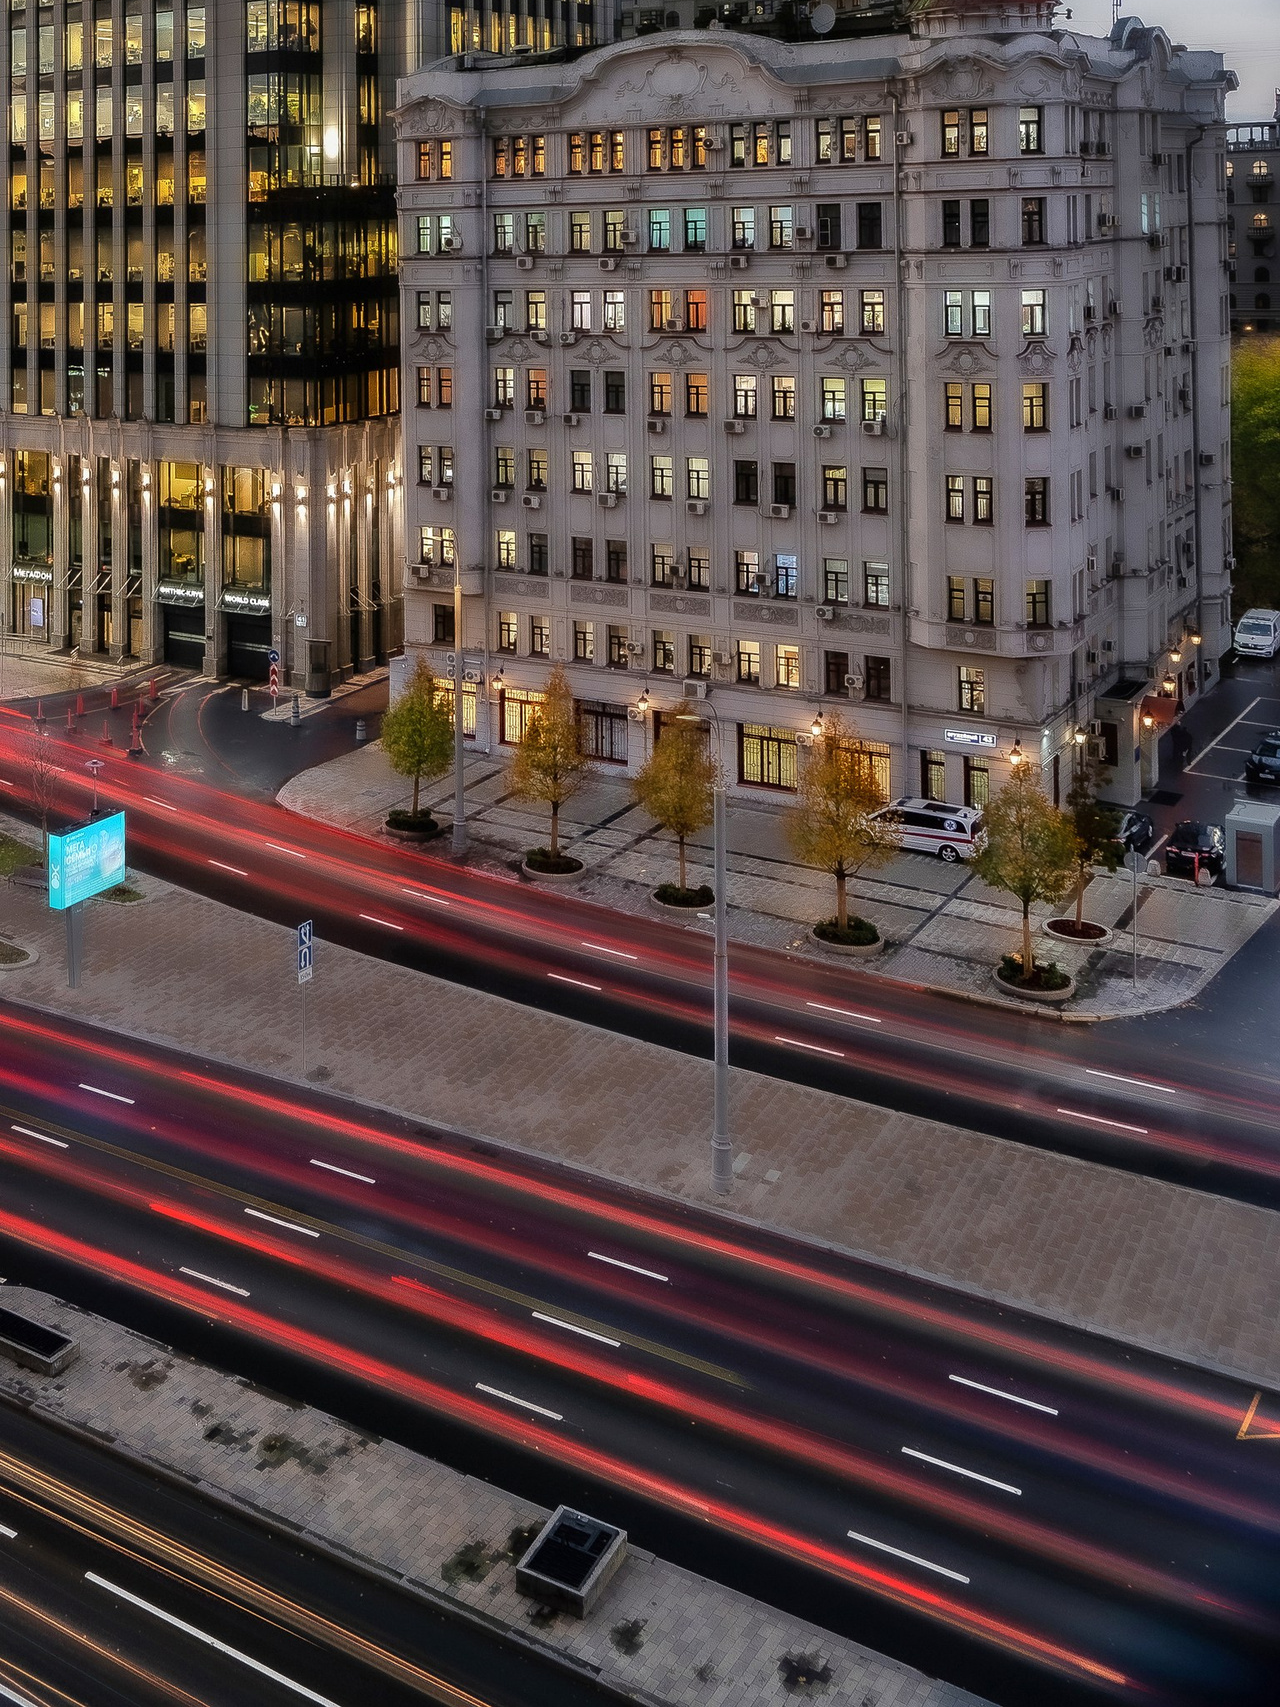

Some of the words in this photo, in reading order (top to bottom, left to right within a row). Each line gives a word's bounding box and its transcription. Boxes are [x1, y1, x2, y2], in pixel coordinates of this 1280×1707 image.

[13, 567, 53, 581] МЕГАФОН
[224, 594, 249, 604] WORLD
[249, 598, 270, 607] CLASS
